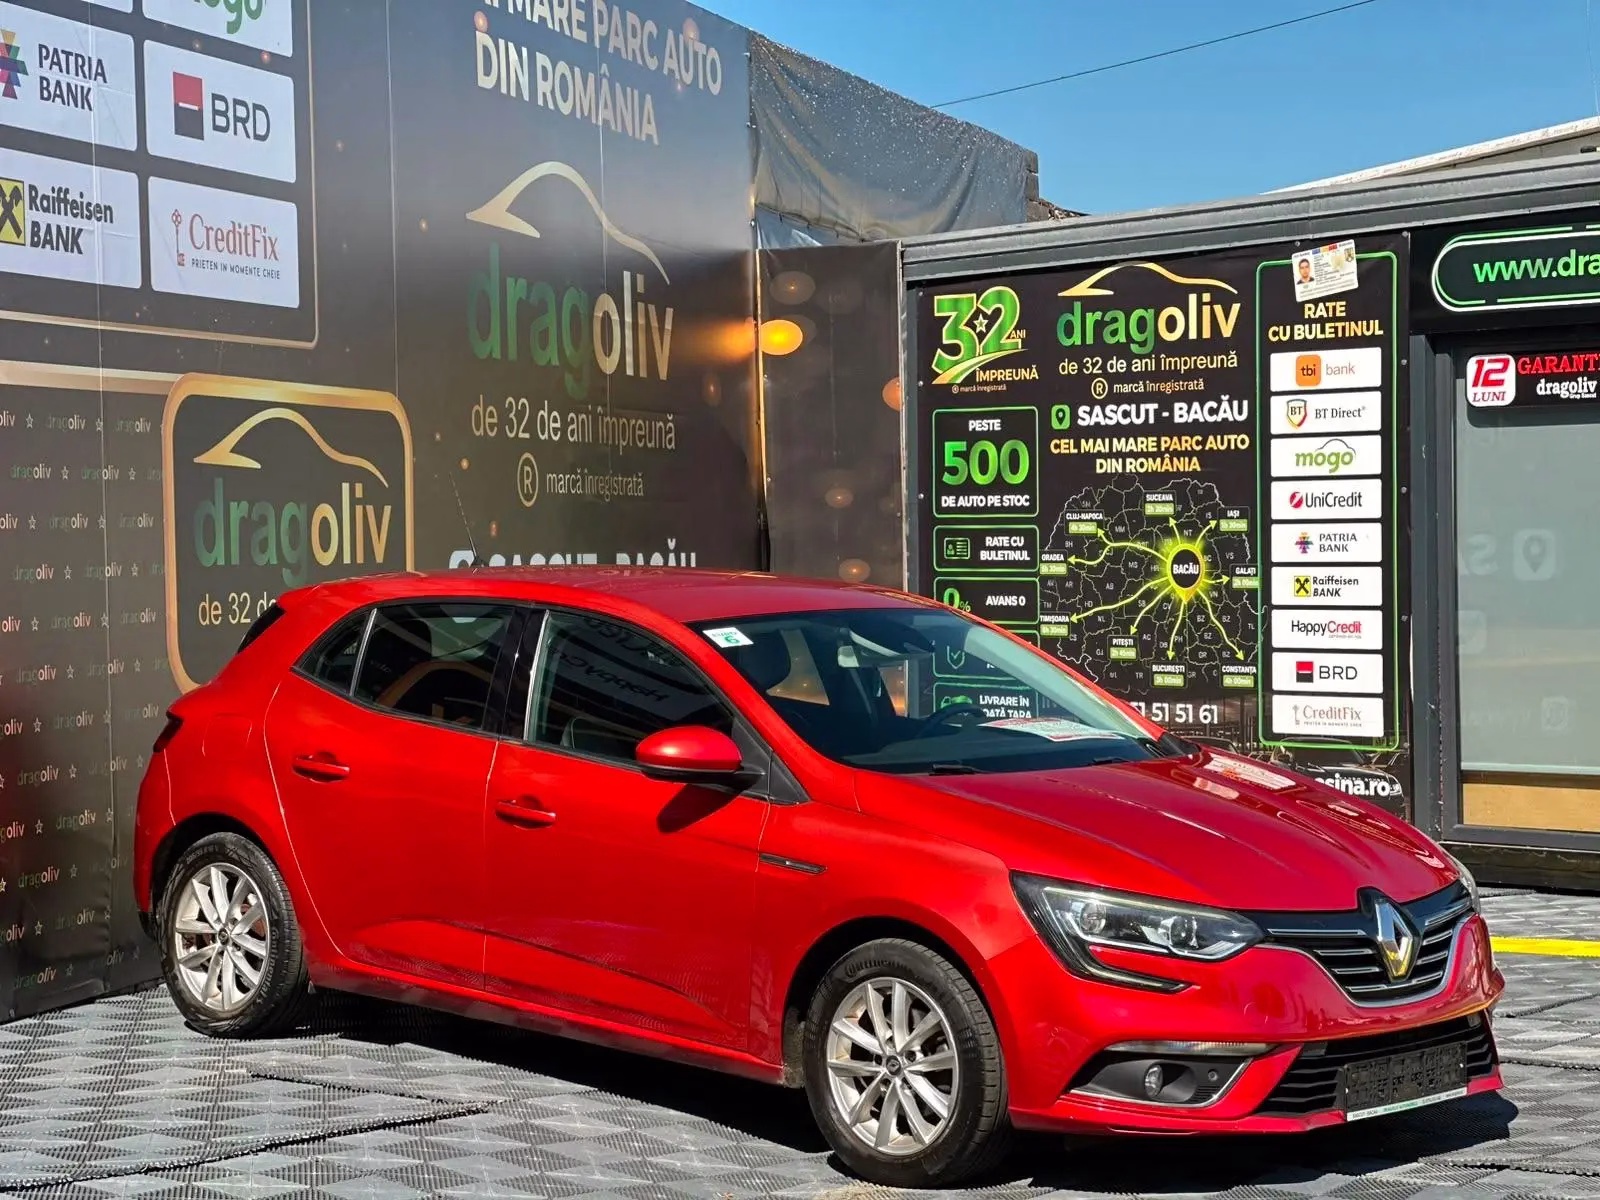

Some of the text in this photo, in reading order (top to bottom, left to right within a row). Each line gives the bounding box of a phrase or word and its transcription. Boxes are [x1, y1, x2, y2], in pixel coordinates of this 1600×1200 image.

[592, 1, 722, 96] PARC AUTO
[38, 43, 108, 84] PATRIA
[39, 76, 93, 111] BANK
[476, 30, 660, 146] DIN ROMÂNIA
[211, 93, 271, 142] BRD
[28, 183, 113, 224] Raiffeisen
[30, 221, 83, 255] BANK
[189, 213, 279, 261] CreditFix
[191, 258, 280, 279] PRIETEN IN MOMENTE CHEIE
[1304, 301, 1346, 319] RATE
[466, 241, 674, 400] dragoliv
[1056, 292, 1241, 355] dragoliv
[1010, 329, 1026, 339] ANI
[1268, 319, 1384, 342] CU BULETINUL
[1058, 350, 1237, 375] de 32 de ani împreună
[1300, 362, 1355, 377] tbi bank
[975, 364, 1039, 382] ÎMPREUNĂ
[1472, 358, 1510, 388] 12
[1113, 378, 1204, 394] marcă înregistrată
[1536, 376, 1598, 398] dragoliv
[1472, 391, 1506, 403] LUNI
[1077, 402, 1158, 426] SASCUT
[1173, 394, 1249, 423] BACĂU
[1290, 406, 1303, 416] BT
[1315, 408, 1328, 419] BT
[471, 394, 676, 455] de 32 de ani împreună
[968, 419, 1001, 431] PESTE
[1050, 433, 1250, 454] CEL MAI MARE PARC AUTO
[942, 440, 1030, 485] 500
[1095, 453, 1201, 473] DIN ROMÂNIA
[1295, 451, 1354, 474] mogo
[546, 467, 644, 502] marcă înregistrată
[941, 495, 1030, 507] DE AUTO PE STOC
[1146, 494, 1173, 502] SUCEAVA
[1305, 491, 1363, 508] UniCredit
[1065, 512, 1103, 520] CLUJ-NAPOCA
[194, 477, 391, 588] dragoliv
[985, 536, 1024, 547] RATE CU
[1319, 533, 1358, 542] PATRIA
[980, 550, 1030, 561] BULETINUL
[1319, 543, 1349, 553] BANK
[1173, 562, 1199, 575] BACĂU
[1312, 575, 1359, 586] Raiffeisen
[985, 595, 1018, 606] AVANS
[1313, 587, 1342, 597] BANK
[198, 592, 251, 626] de 32
[1291, 619, 1362, 637] HappyCredit
[1319, 665, 1358, 680] BRD
[979, 694, 1018, 706] LIVRARE
[1151, 702, 1218, 724] 51 51 61
[1303, 704, 1362, 721] CreditFix
